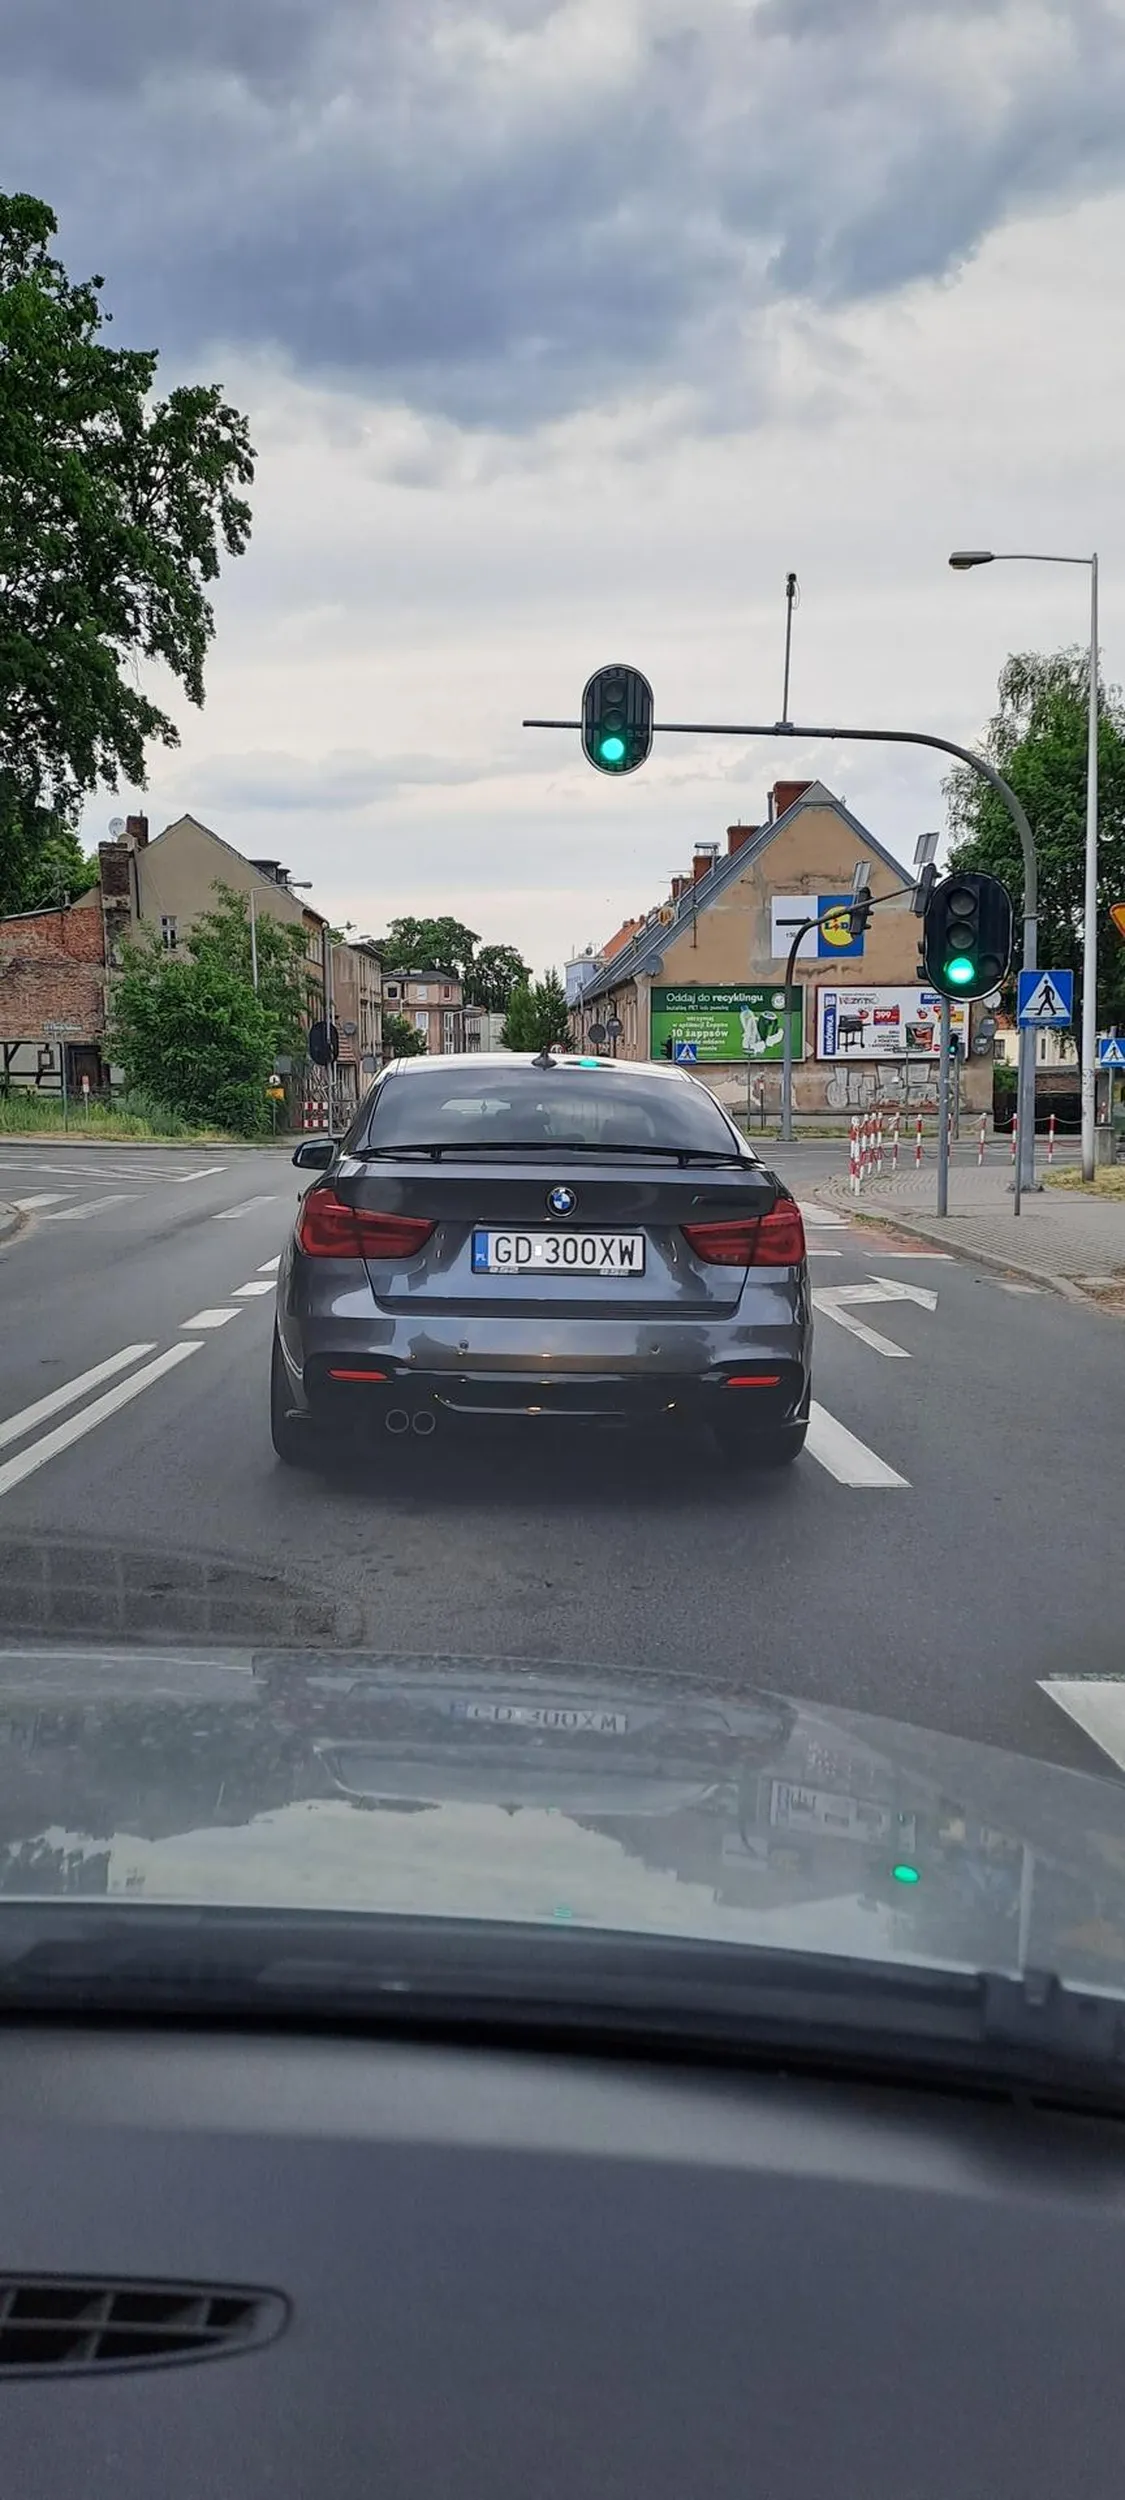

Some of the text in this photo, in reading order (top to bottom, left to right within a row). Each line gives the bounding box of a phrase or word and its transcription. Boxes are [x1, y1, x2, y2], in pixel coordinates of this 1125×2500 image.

[824, 916, 850, 932] LID
[666, 993, 764, 1004] Oddaj do recyklingu
[875, 1011, 892, 1019] 399
[671, 1028, 729, 1039] 10 żappsów
[495, 1236, 635, 1266] GD 300XW
[475, 1253, 486, 1262] PL
